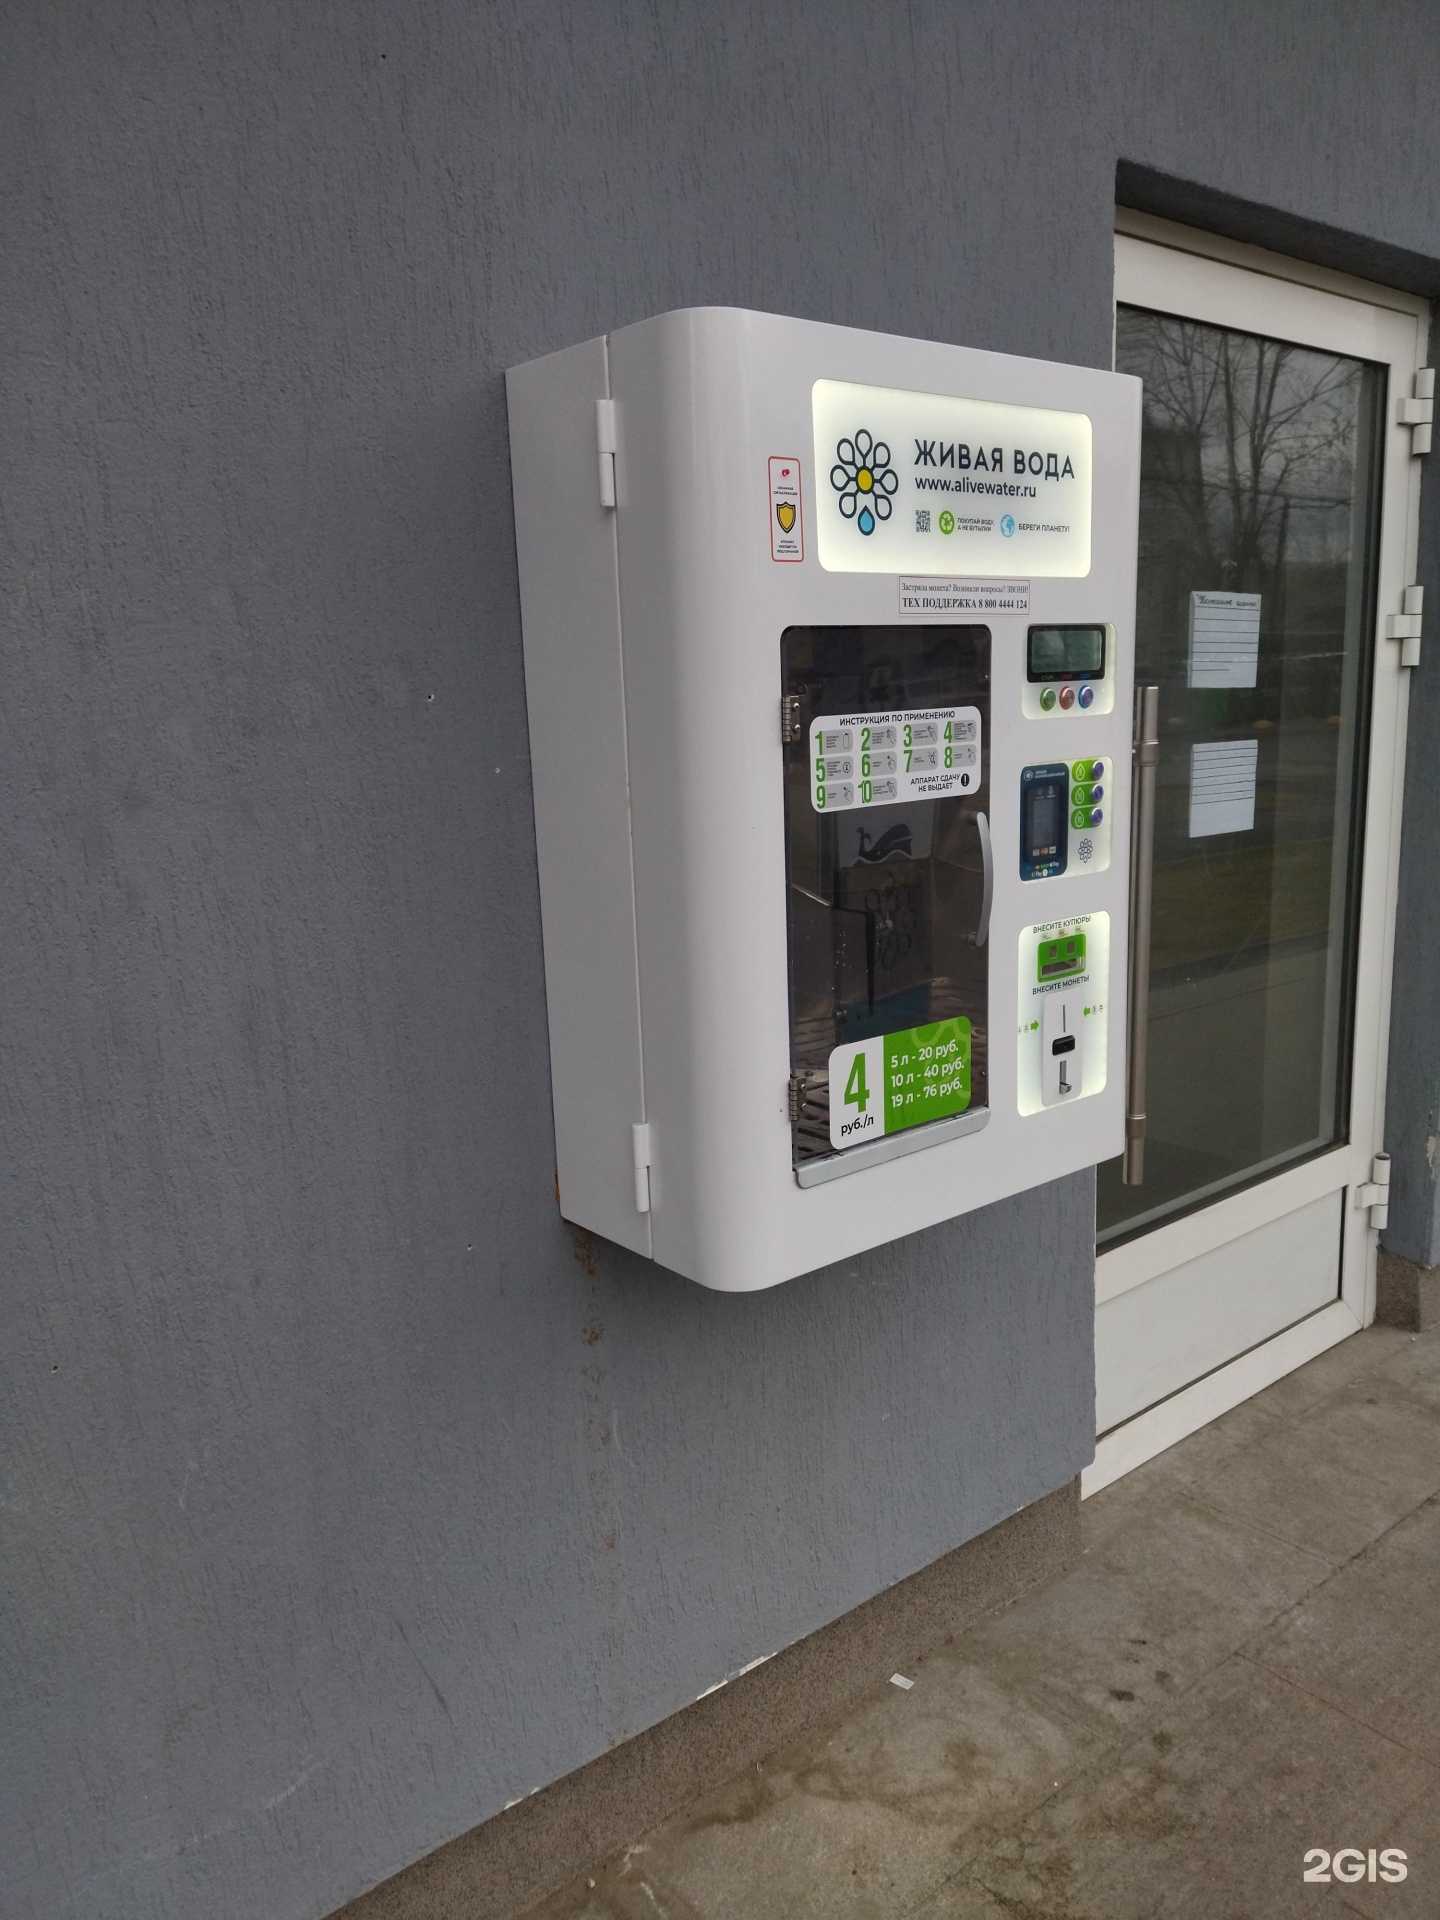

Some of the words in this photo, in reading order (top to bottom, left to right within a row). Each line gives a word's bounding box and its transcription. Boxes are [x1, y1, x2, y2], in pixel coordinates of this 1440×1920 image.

[914, 439, 1004, 473] ЖИВАЯ
[1013, 449, 1075, 481] ВОДА
[914, 475, 1037, 498] www.alivewater.ru
[1018, 523, 1041, 532] БЕРЕГИ
[903, 597, 920, 608] ТЕХ
[922, 598, 977, 609] ПОДДЕРЖКА
[978, 599, 983, 608] 8
[984, 600, 997, 609] 800
[998, 600, 1014, 609] 4444
[1016, 600, 1028, 609] 124
[839, 714, 890, 727] ИНСТРУКЦИЯ
[891, 714, 903, 723] ПО
[904, 710, 956, 721] ПРИМЕНЕНИЮ
[815, 730, 824, 755] 1
[861, 727, 871, 752] 2
[903, 724, 912, 747] 3
[943, 720, 953, 743] 4
[861, 754, 871, 777] 6
[903, 749, 913, 773] 7
[944, 746, 953, 768] 8
[815, 757, 826, 782] 5
[910, 775, 939, 785] АППАРАТ
[940, 773, 961, 782] СДАЧУ
[816, 785, 826, 809] 9
[858, 780, 872, 804] 10
[918, 784, 927, 792] НЕ
[927, 782, 953, 792] ВЫДАЕТ
[1032, 921, 1062, 934] ВНЕСИТЕ
[1063, 915, 1092, 928] КУПЮРЫ
[1032, 983, 1062, 996] ВНЕСИТЕ
[1062, 975, 1090, 988] МОНЕТЫ
[891, 1055, 899, 1068] 5
[900, 1054, 909, 1066] л
[918, 1046, 933, 1061] 20
[935, 1039, 959, 1060] руб.
[843, 1051, 870, 1113] 4
[891, 1073, 904, 1088] 10
[905, 1073, 914, 1084] л
[923, 1065, 939, 1079] 40
[941, 1056, 965, 1077] руб.
[891, 1093, 904, 1109] 19
[905, 1093, 914, 1104] л
[923, 1085, 937, 1100] 76
[939, 1076, 963, 1096] руб.
[840, 1113, 874, 1137] руб./л
